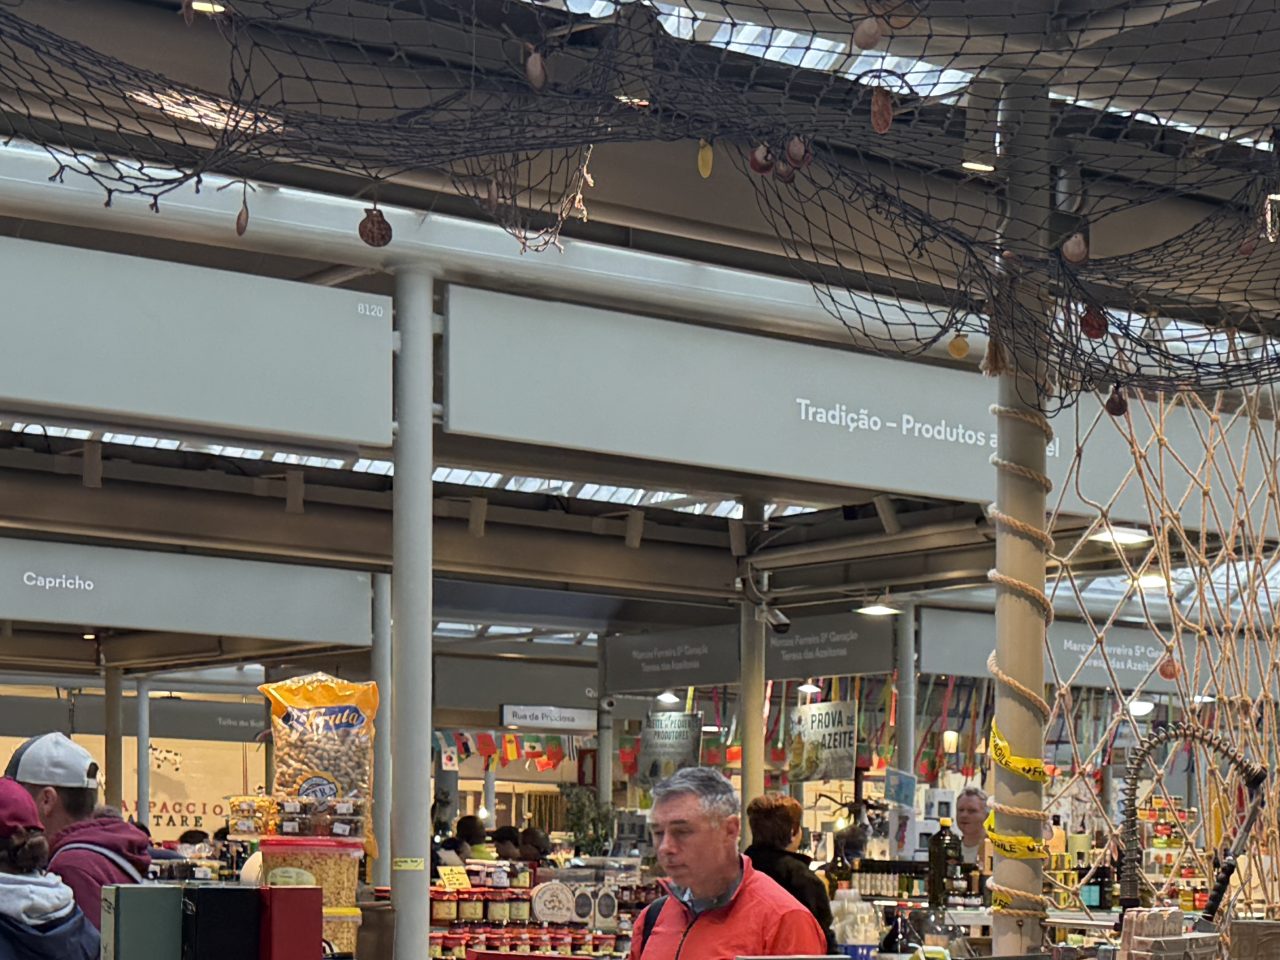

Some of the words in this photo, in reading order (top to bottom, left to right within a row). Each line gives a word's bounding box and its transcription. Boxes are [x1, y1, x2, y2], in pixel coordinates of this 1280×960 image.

[796, 398, 881, 432] Tradição
[902, 414, 985, 446] Produtos
[23, 572, 94, 591] Capricho
[512, 711, 528, 720] Rua
[529, 712, 539, 721] da
[810, 710, 843, 730] PROVA
[820, 731, 854, 750] AZEITE
